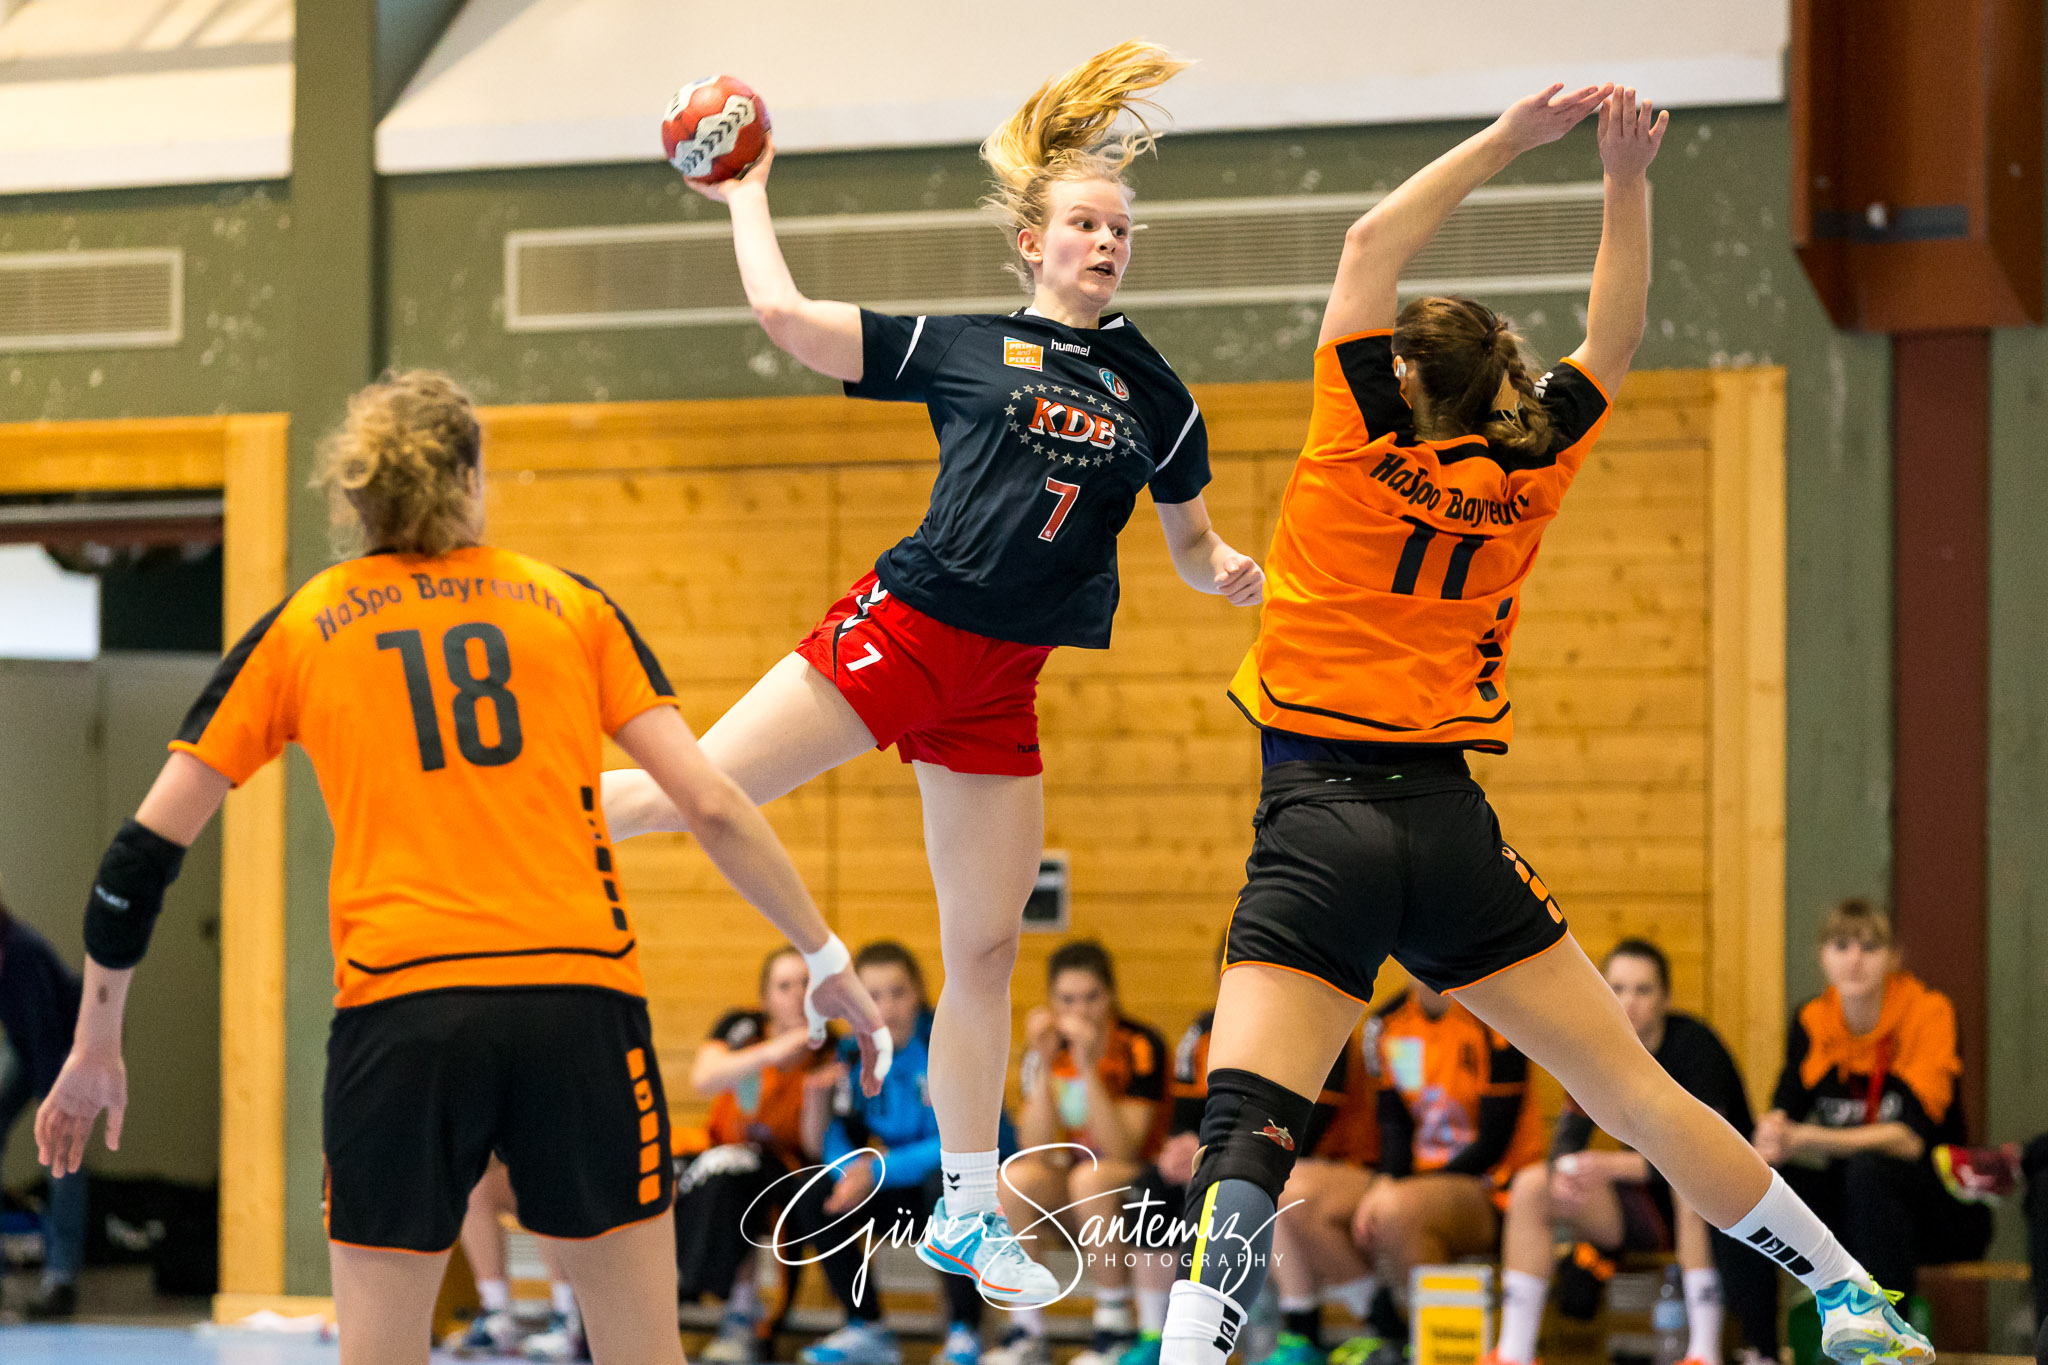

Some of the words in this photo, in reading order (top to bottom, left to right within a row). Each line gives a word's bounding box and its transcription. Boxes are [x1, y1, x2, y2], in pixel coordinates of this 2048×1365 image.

[1008, 356, 1037, 364] PIXEL
[1051, 339, 1091, 357] hummel
[1028, 397, 1116, 450] KDE
[1038, 476, 1081, 542] 7
[1370, 453, 1441, 511] HaSpo
[1391, 515, 1486, 600] 11
[314, 585, 402, 642] HaSpo
[411, 573, 563, 618] Bayreuth
[846, 642, 883, 672] 7
[375, 621, 523, 772] 18
